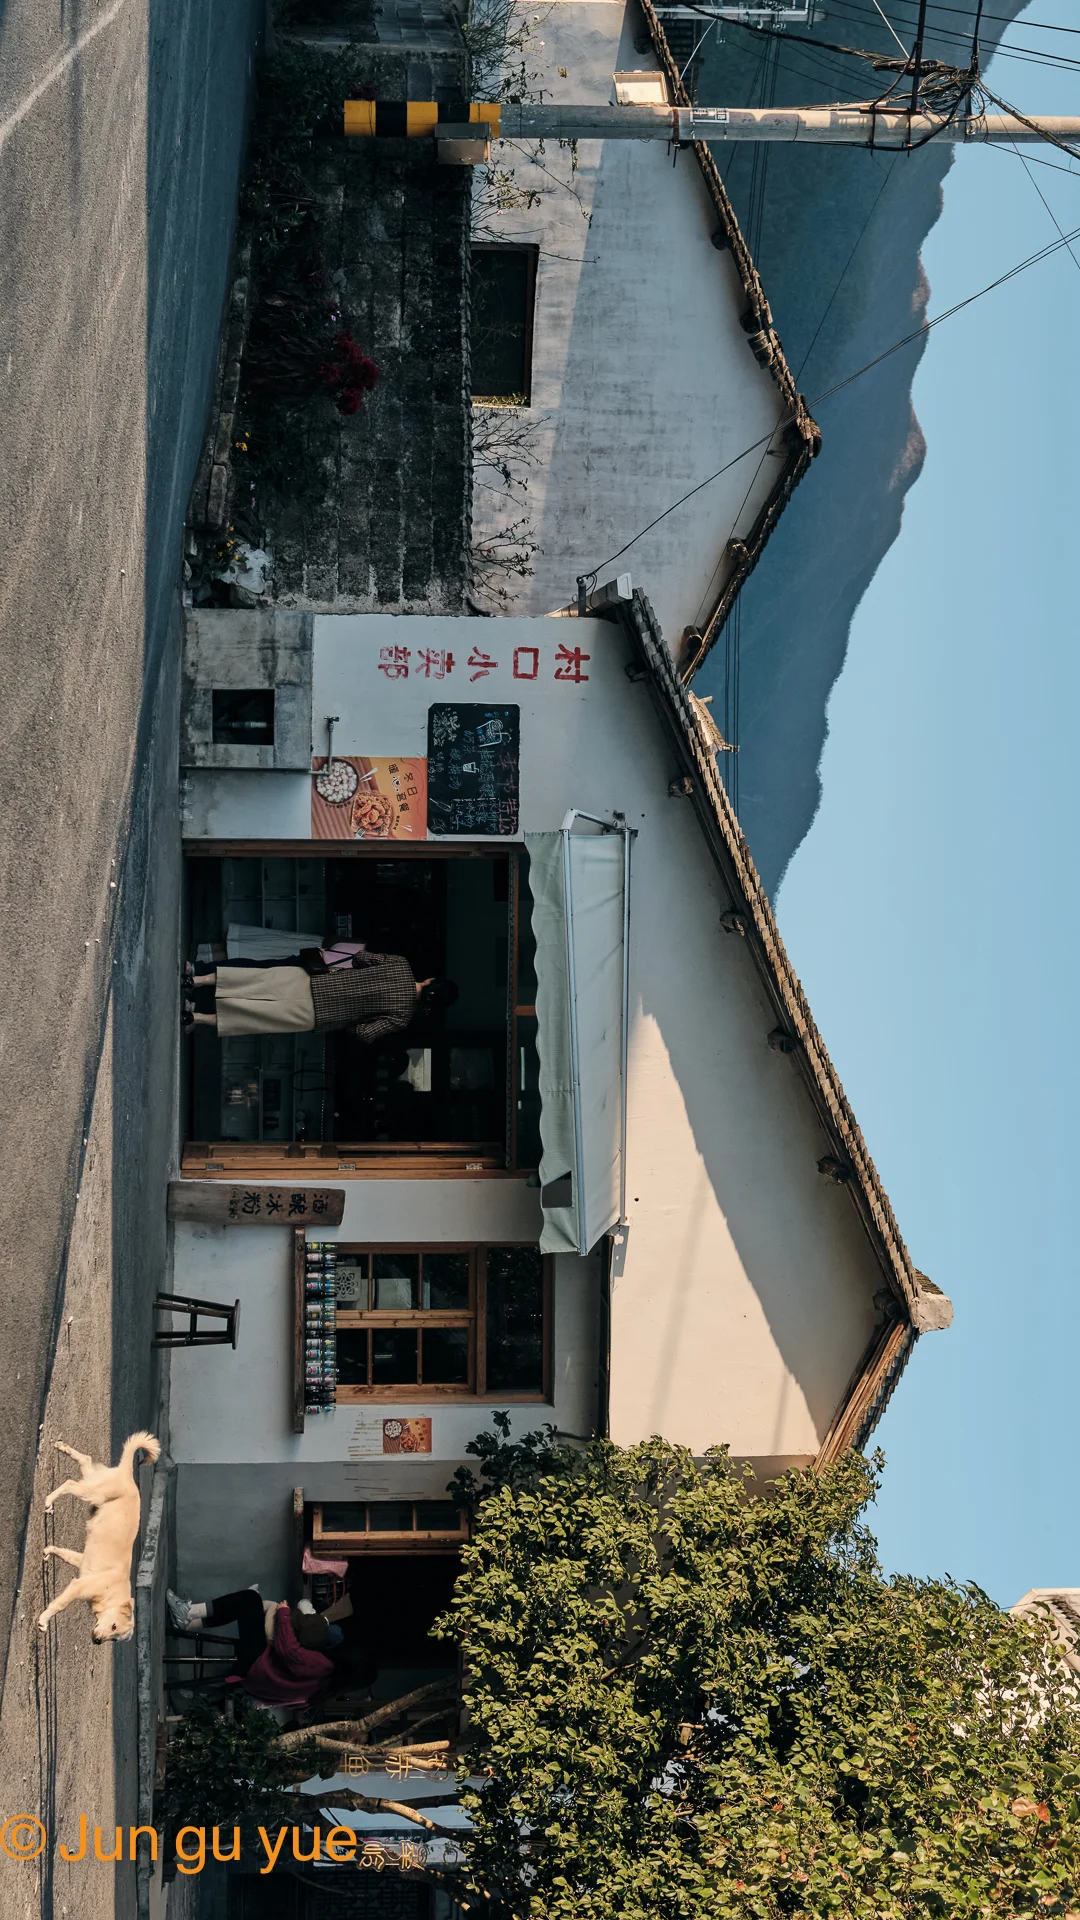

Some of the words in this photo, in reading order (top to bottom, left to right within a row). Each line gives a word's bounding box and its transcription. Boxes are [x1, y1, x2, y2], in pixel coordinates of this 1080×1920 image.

[377, 643, 591, 684] 村口小卖部
[387, 763, 410, 813] 暖心套餐
[403, 772, 418, 797] 冬日
[241, 1191, 330, 1217] 酒酿冰粉
